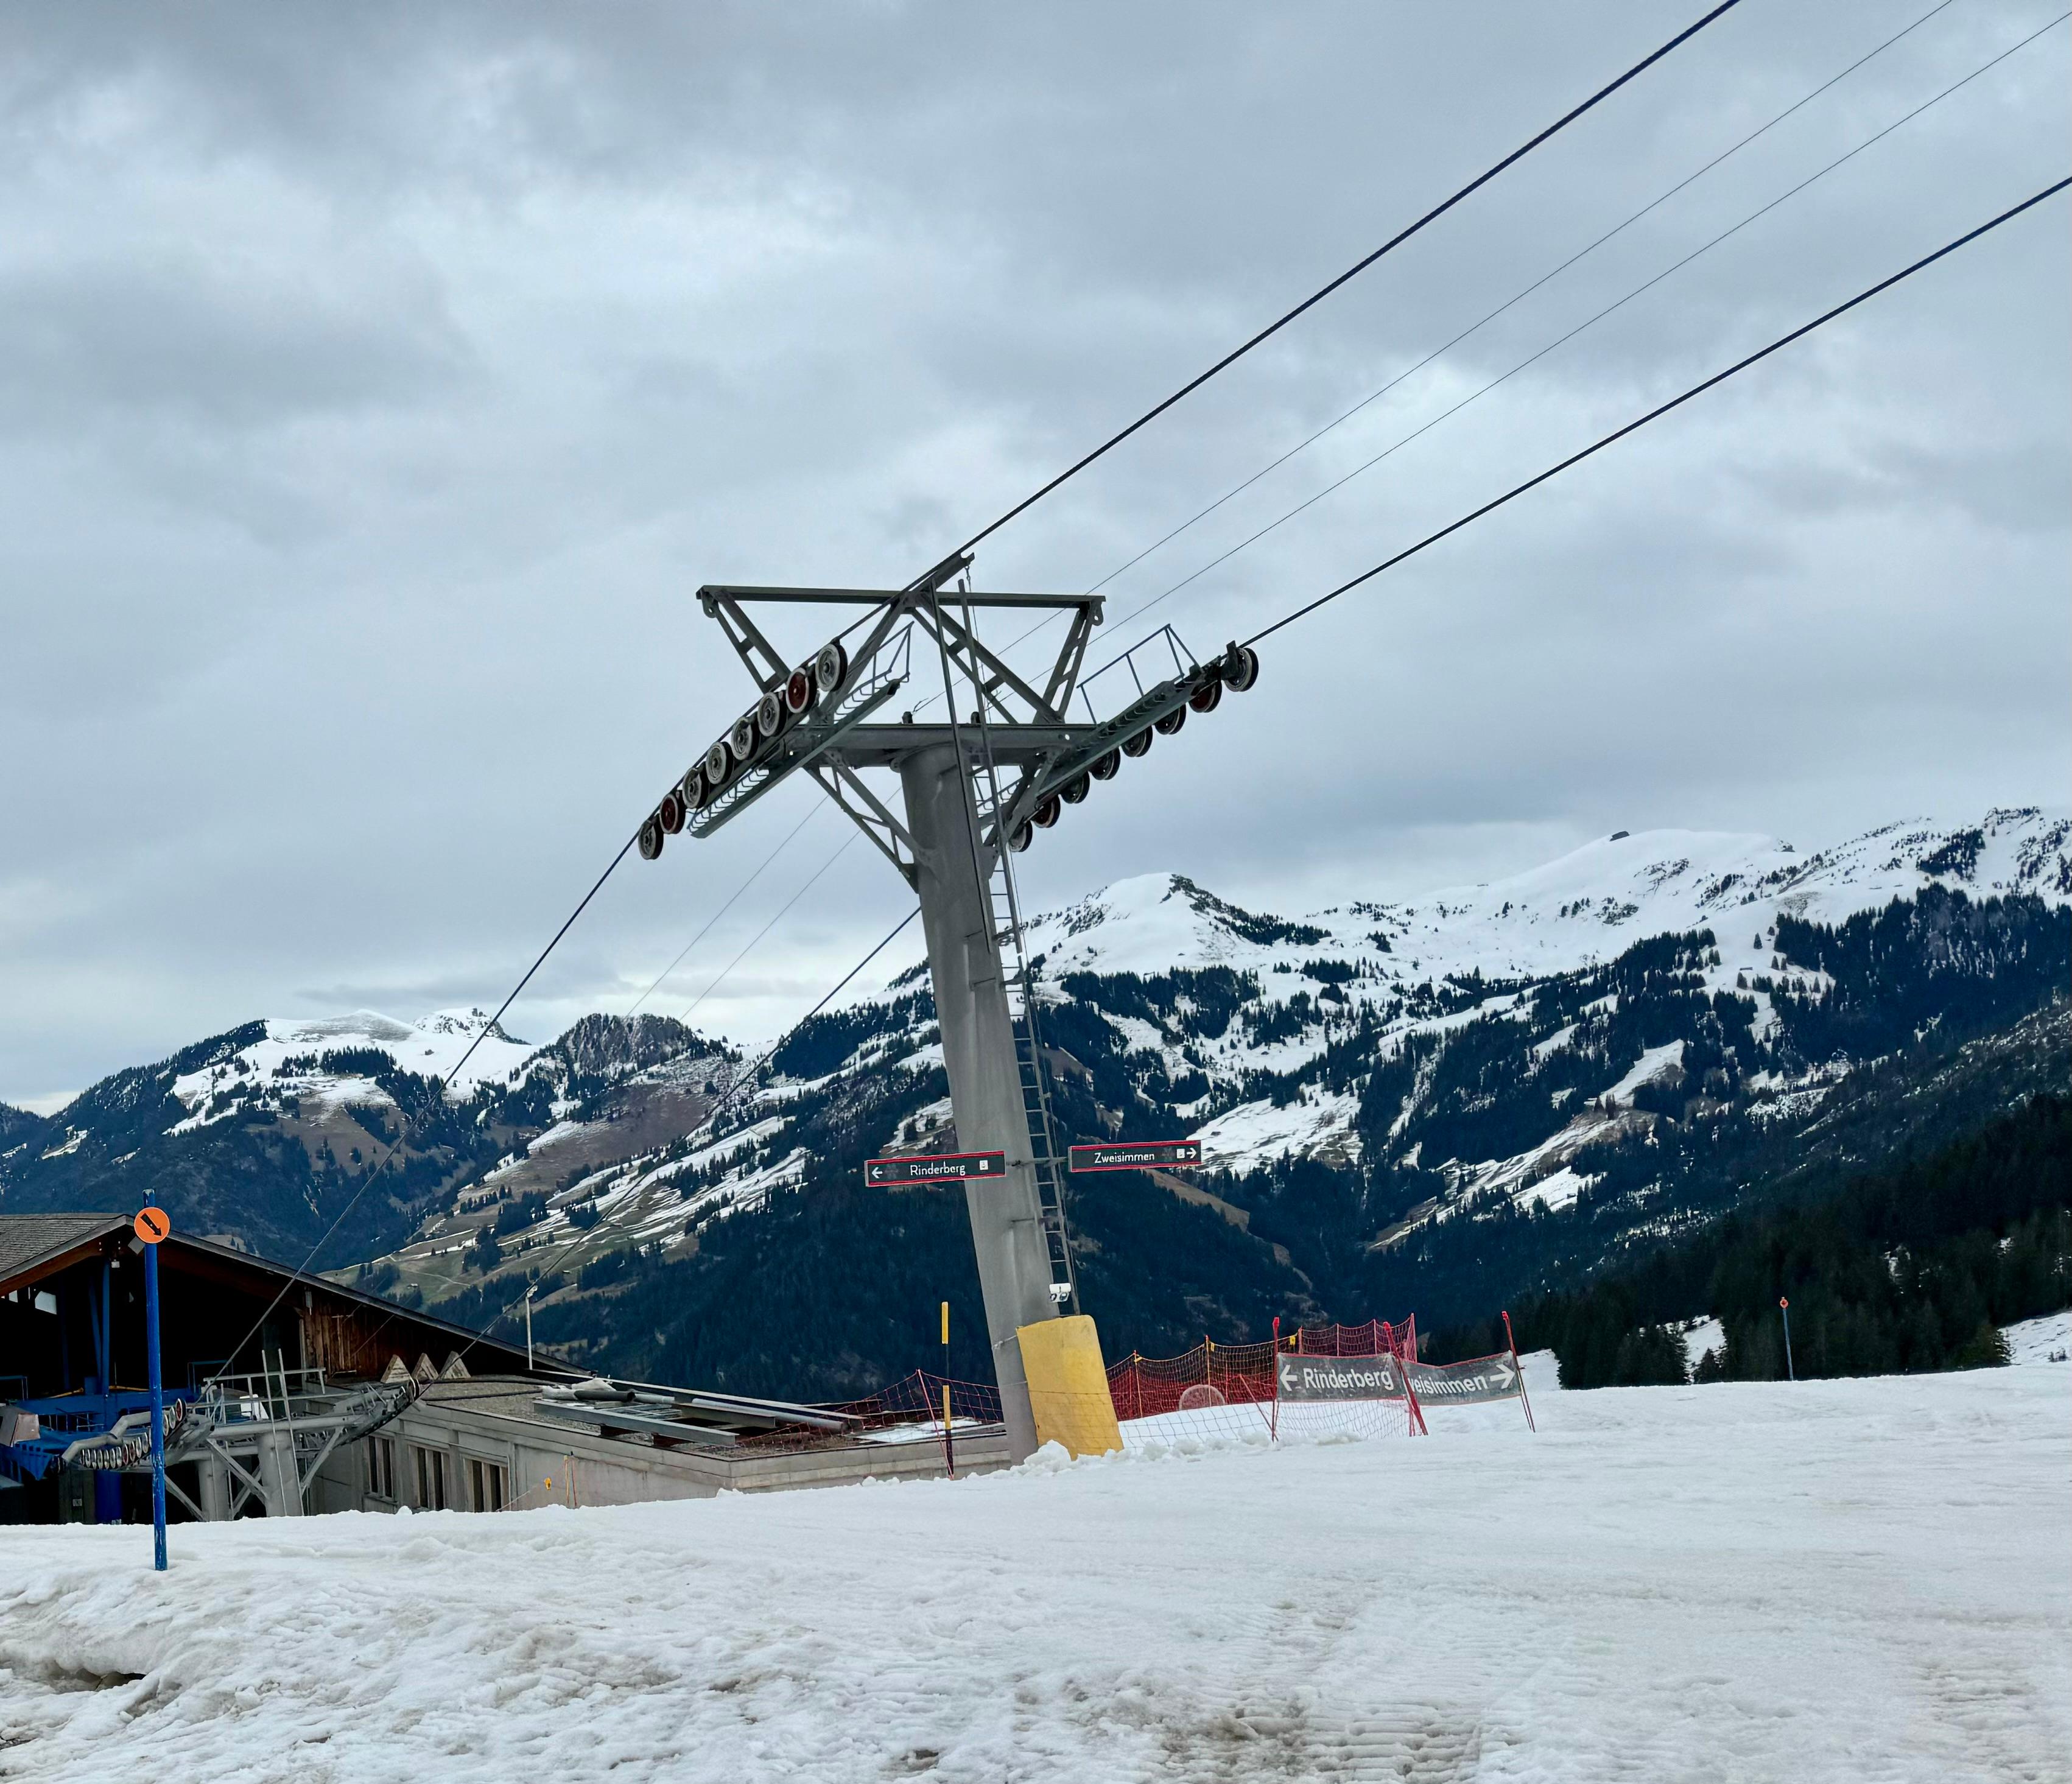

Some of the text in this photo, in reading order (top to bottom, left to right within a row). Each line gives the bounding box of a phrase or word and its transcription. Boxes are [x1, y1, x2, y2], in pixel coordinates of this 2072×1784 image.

[1094, 1151, 1155, 1164] Zweisimmen
[910, 1161, 966, 1176] Rinderberg
[1303, 1368, 1394, 1391] Rinderberg
